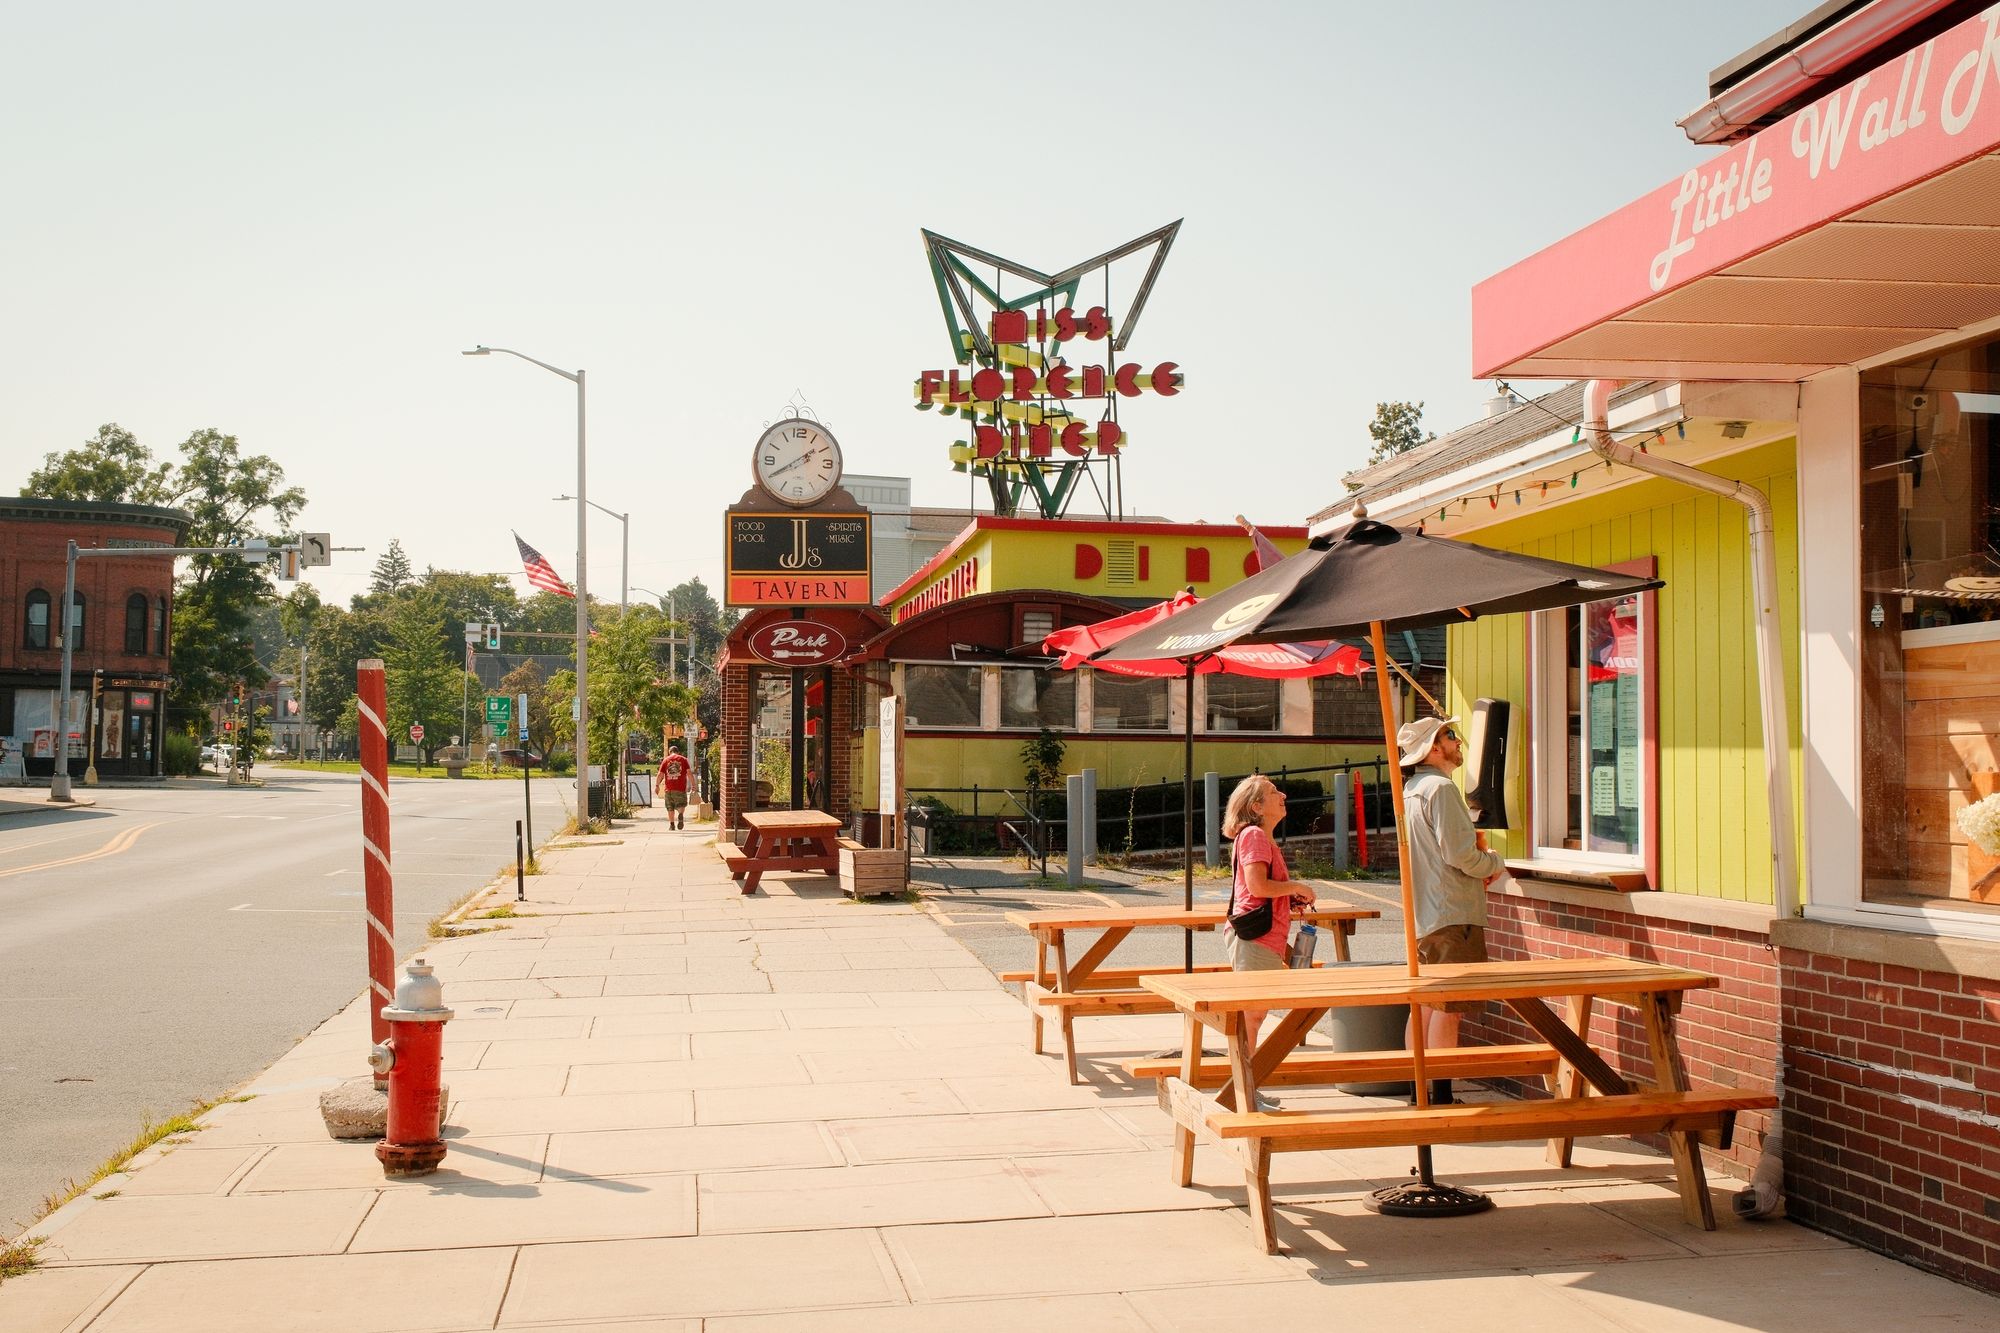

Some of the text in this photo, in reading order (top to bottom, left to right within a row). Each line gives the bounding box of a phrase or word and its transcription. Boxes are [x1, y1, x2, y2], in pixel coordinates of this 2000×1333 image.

[1649, 137, 1773, 292] Little
[1790, 38, 1935, 180] Wall
[991, 306, 1110, 344] MISS
[920, 361, 1181, 405] FLORENCE
[792, 428, 807, 438] 12
[975, 420, 1122, 459] DINER
[764, 455, 775, 466] 9
[822, 459, 834, 469] 3
[738, 522, 765, 531] FOOD
[829, 523, 862, 532] SPIRITS
[738, 534, 765, 543] POOL
[829, 535, 855, 544] MUSIC
[753, 581, 848, 600] TAVERN
[770, 627, 829, 647] Park
